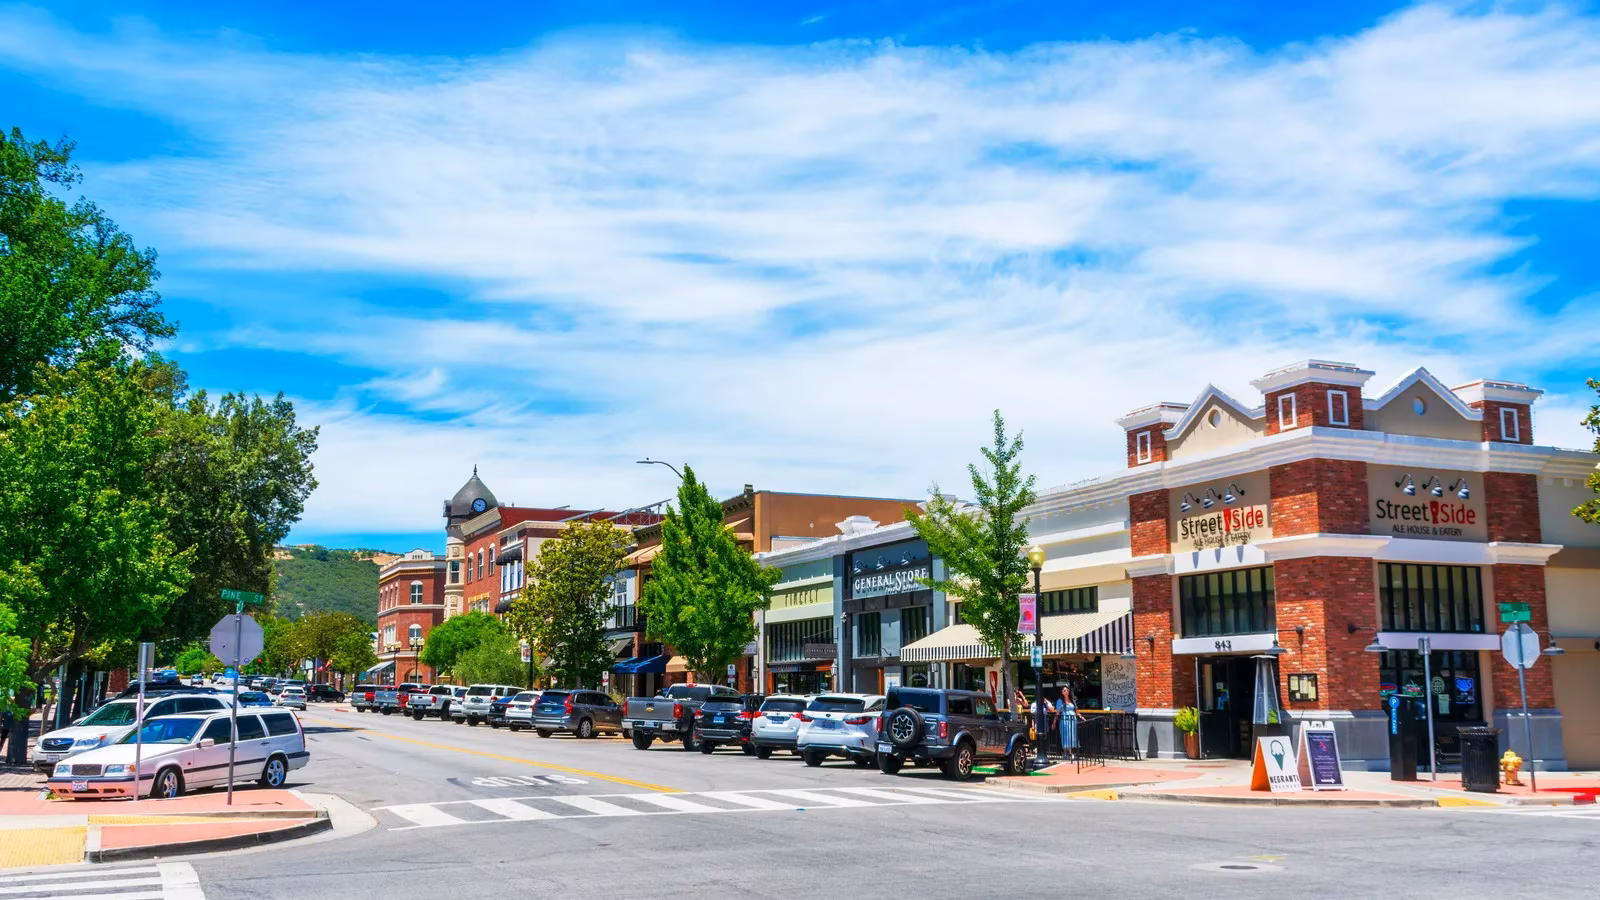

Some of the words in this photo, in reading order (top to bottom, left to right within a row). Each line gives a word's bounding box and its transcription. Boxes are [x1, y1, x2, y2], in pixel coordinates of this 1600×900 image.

[1181, 513, 1223, 536] Street
[1232, 505, 1264, 530] Side
[1376, 499, 1430, 521] Street
[1440, 503, 1476, 524] Side
[1392, 524, 1406, 533] ALE
[1407, 525, 1430, 535] HOUSE
[1432, 526, 1438, 536] &
[1439, 527, 1463, 536] EATERY
[854, 574, 894, 590] GENERAL
[895, 568, 927, 591] STORE
[221, 589, 241, 600] PINE
[254, 594, 264, 603] ST
[1214, 640, 1232, 649] 843
